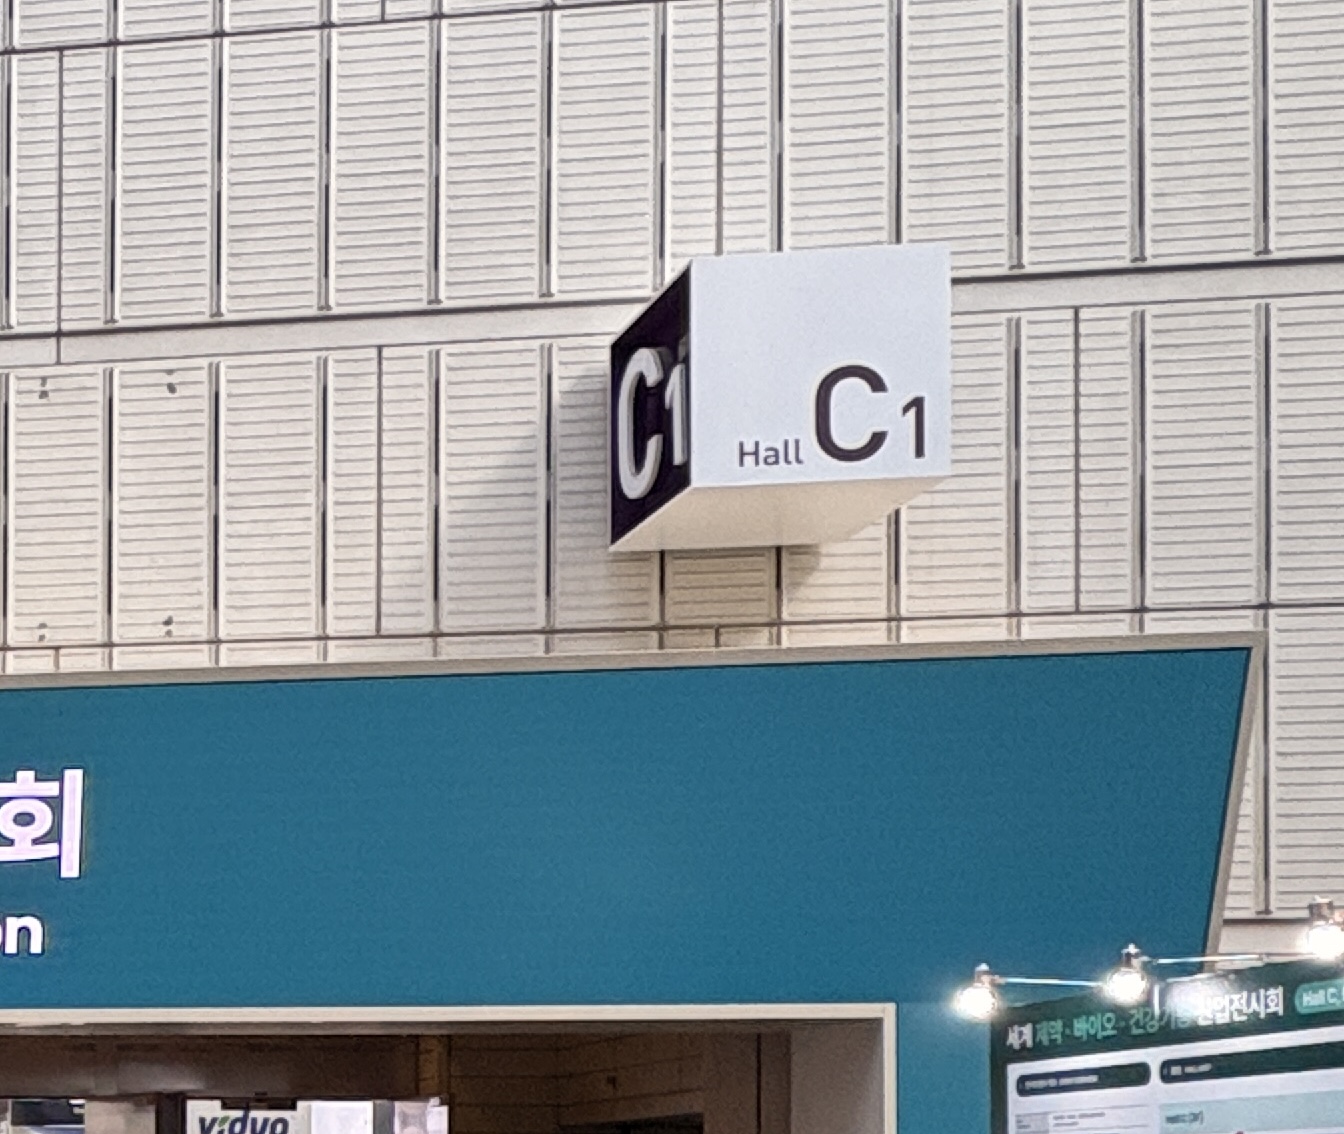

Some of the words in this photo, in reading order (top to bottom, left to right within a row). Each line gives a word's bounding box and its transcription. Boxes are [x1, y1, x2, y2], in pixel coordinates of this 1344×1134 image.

[618, 348, 687, 500] C1
[738, 438, 804, 468] Hall
[814, 364, 926, 462] C1
